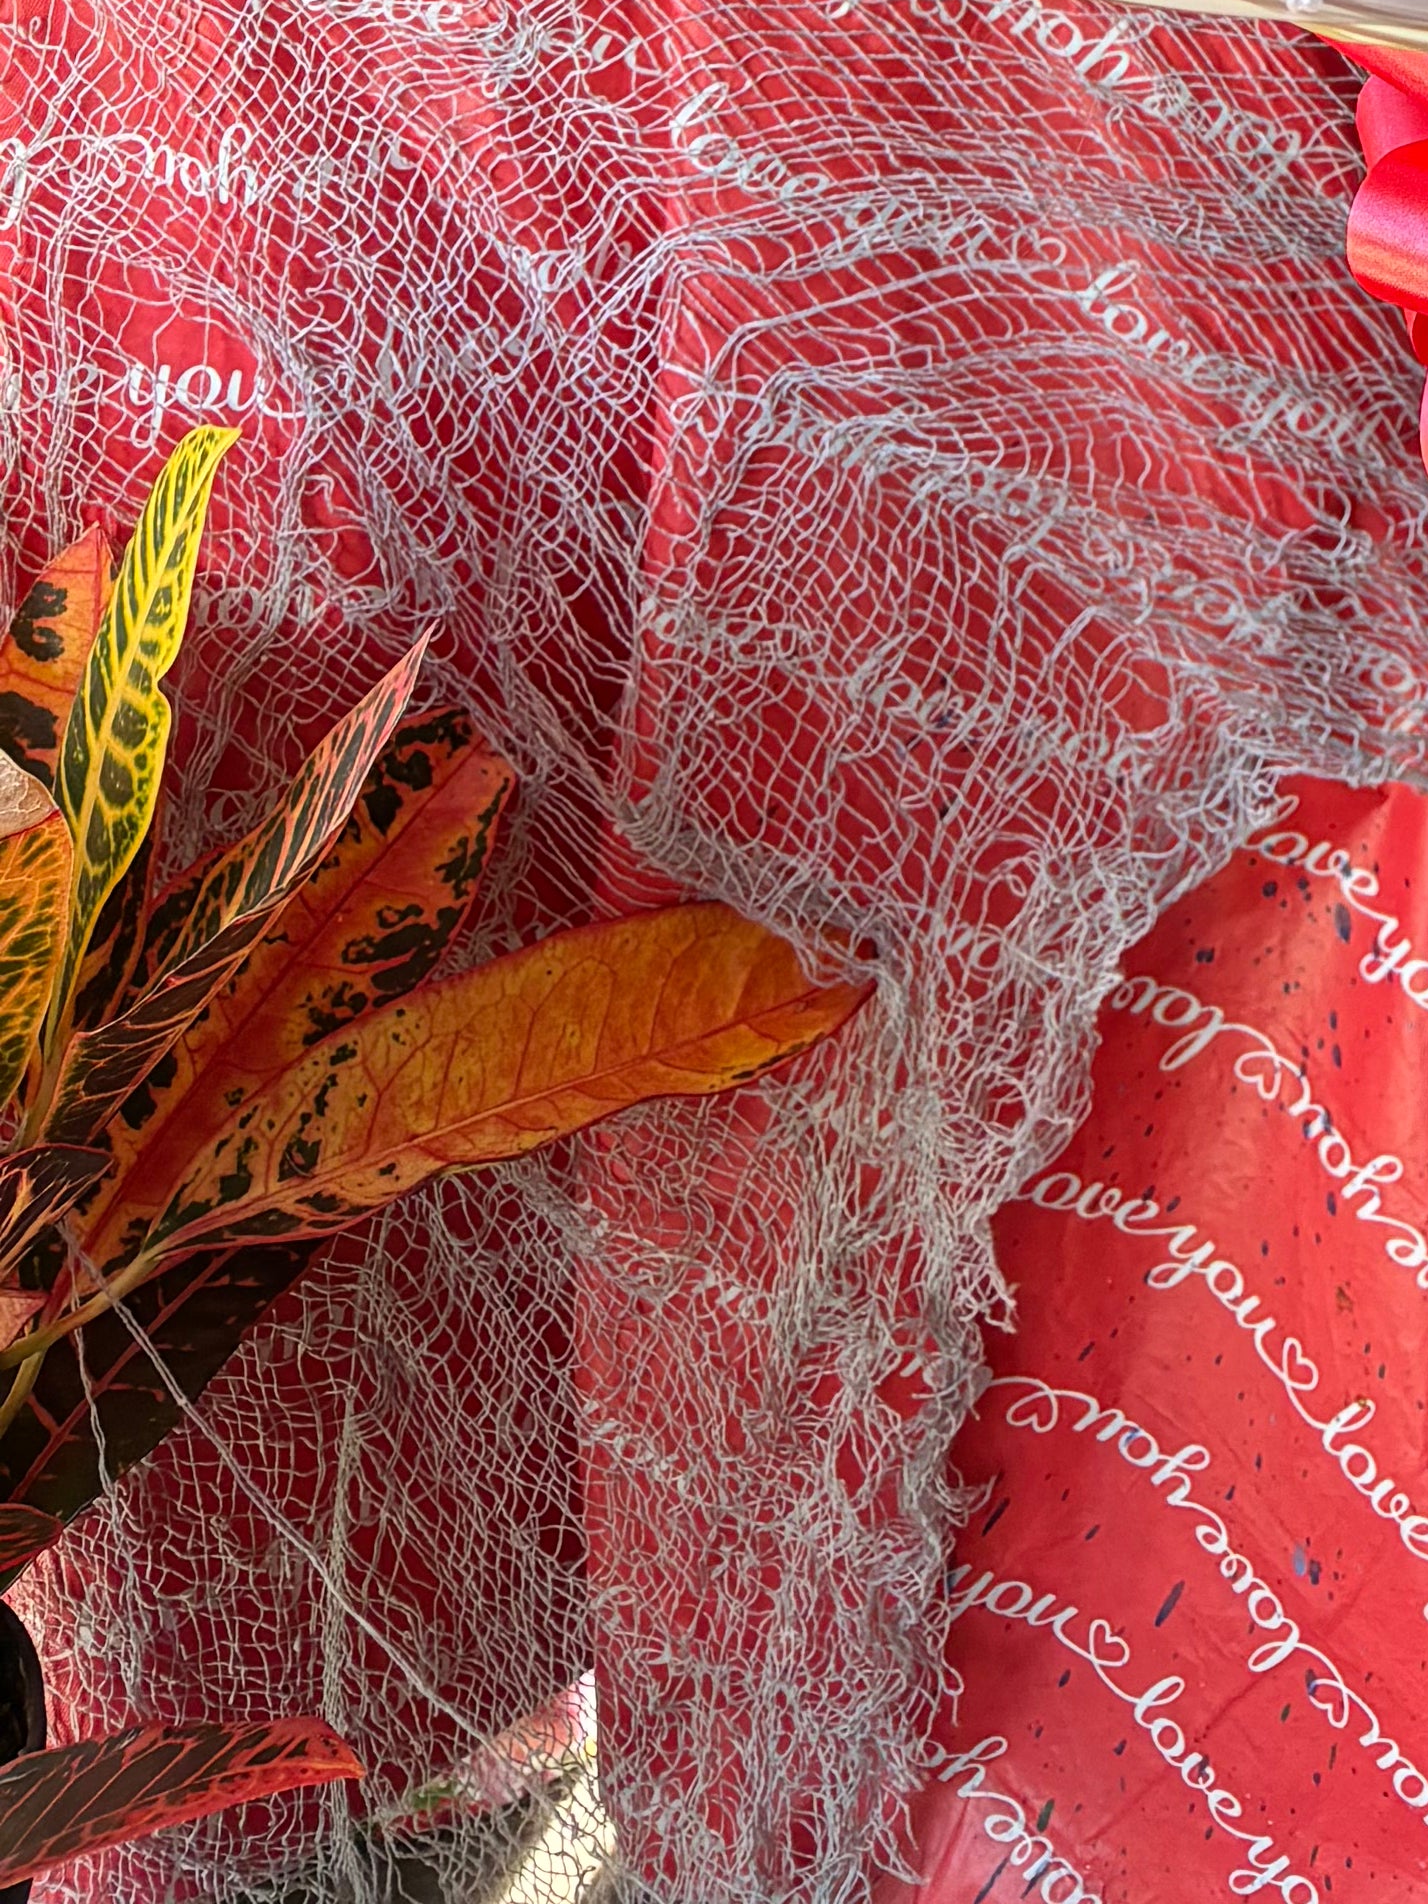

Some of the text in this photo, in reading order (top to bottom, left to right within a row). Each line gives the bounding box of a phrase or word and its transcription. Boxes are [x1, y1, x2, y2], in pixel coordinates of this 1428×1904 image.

[671, 81, 829, 202] love
[1078, 258, 1245, 394] love
[127, 364, 290, 449] you
[1110, 974, 1404, 1219] you lov
[1015, 1170, 1161, 1235] ove
[1144, 1224, 1277, 1334] you
[1072, 1392, 1301, 1673] love you
[945, 1562, 1319, 1904] you love yo
